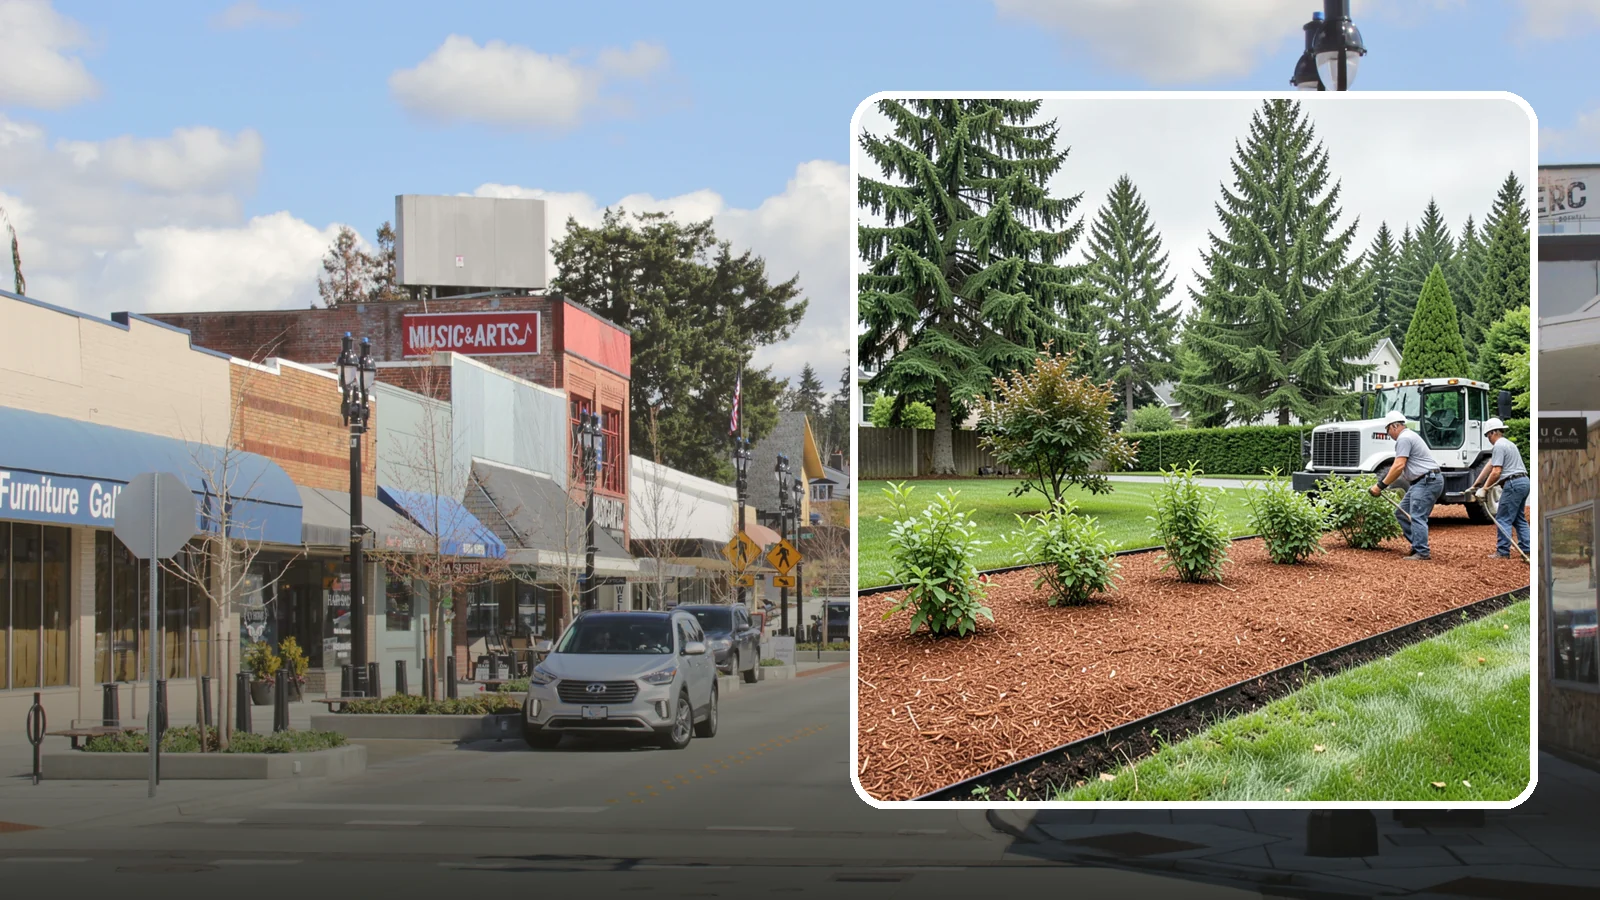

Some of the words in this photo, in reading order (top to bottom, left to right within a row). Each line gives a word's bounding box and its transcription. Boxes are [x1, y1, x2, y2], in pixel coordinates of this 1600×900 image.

[408, 323, 520, 349] MUSIC&ARTS
[1540, 427, 1578, 437] UGA
[0, 472, 79, 516] Furniture
[89, 482, 122, 520] Gal
[453, 563, 480, 575] SUSHI
